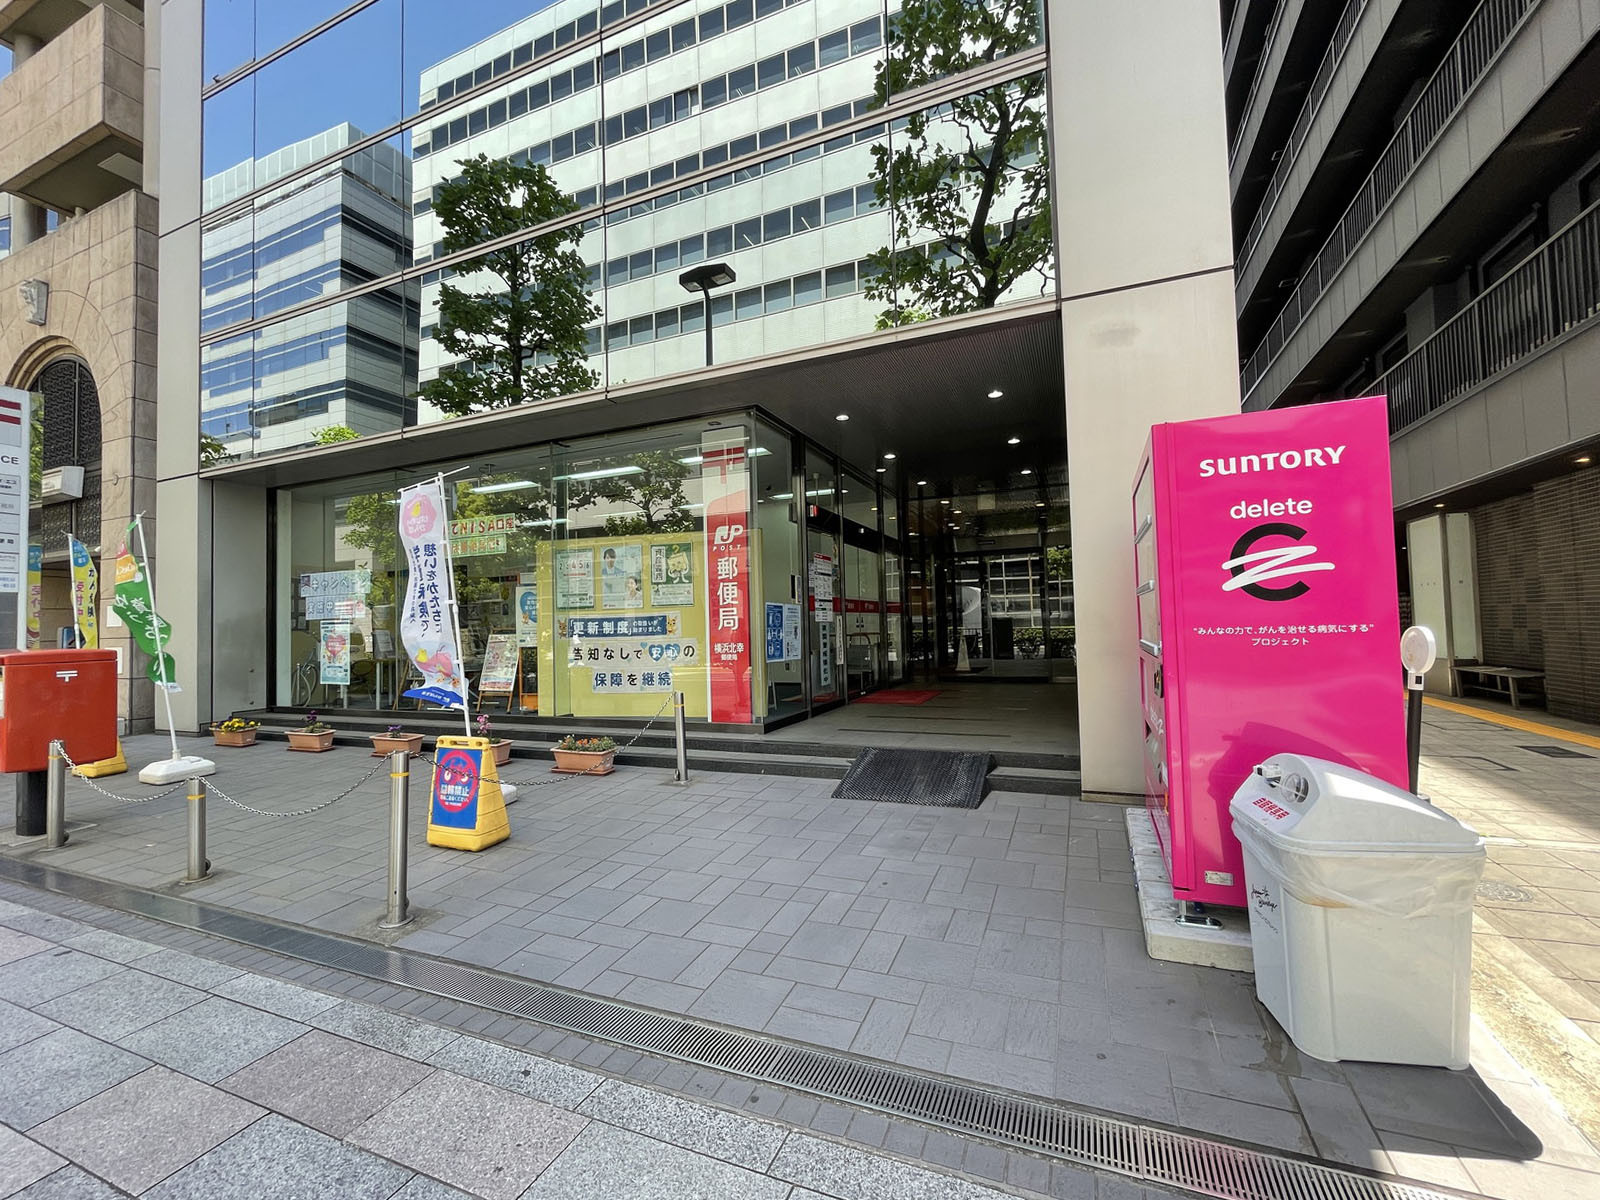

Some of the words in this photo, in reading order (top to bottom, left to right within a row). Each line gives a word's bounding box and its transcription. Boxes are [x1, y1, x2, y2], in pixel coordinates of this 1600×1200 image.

[1230, 498, 1312, 519] delete
[713, 544, 741, 552] POST
[717, 556, 739, 630] 郵便局
[1251, 637, 1310, 646] プロジェクト
[594, 671, 672, 687] 保障を継続
